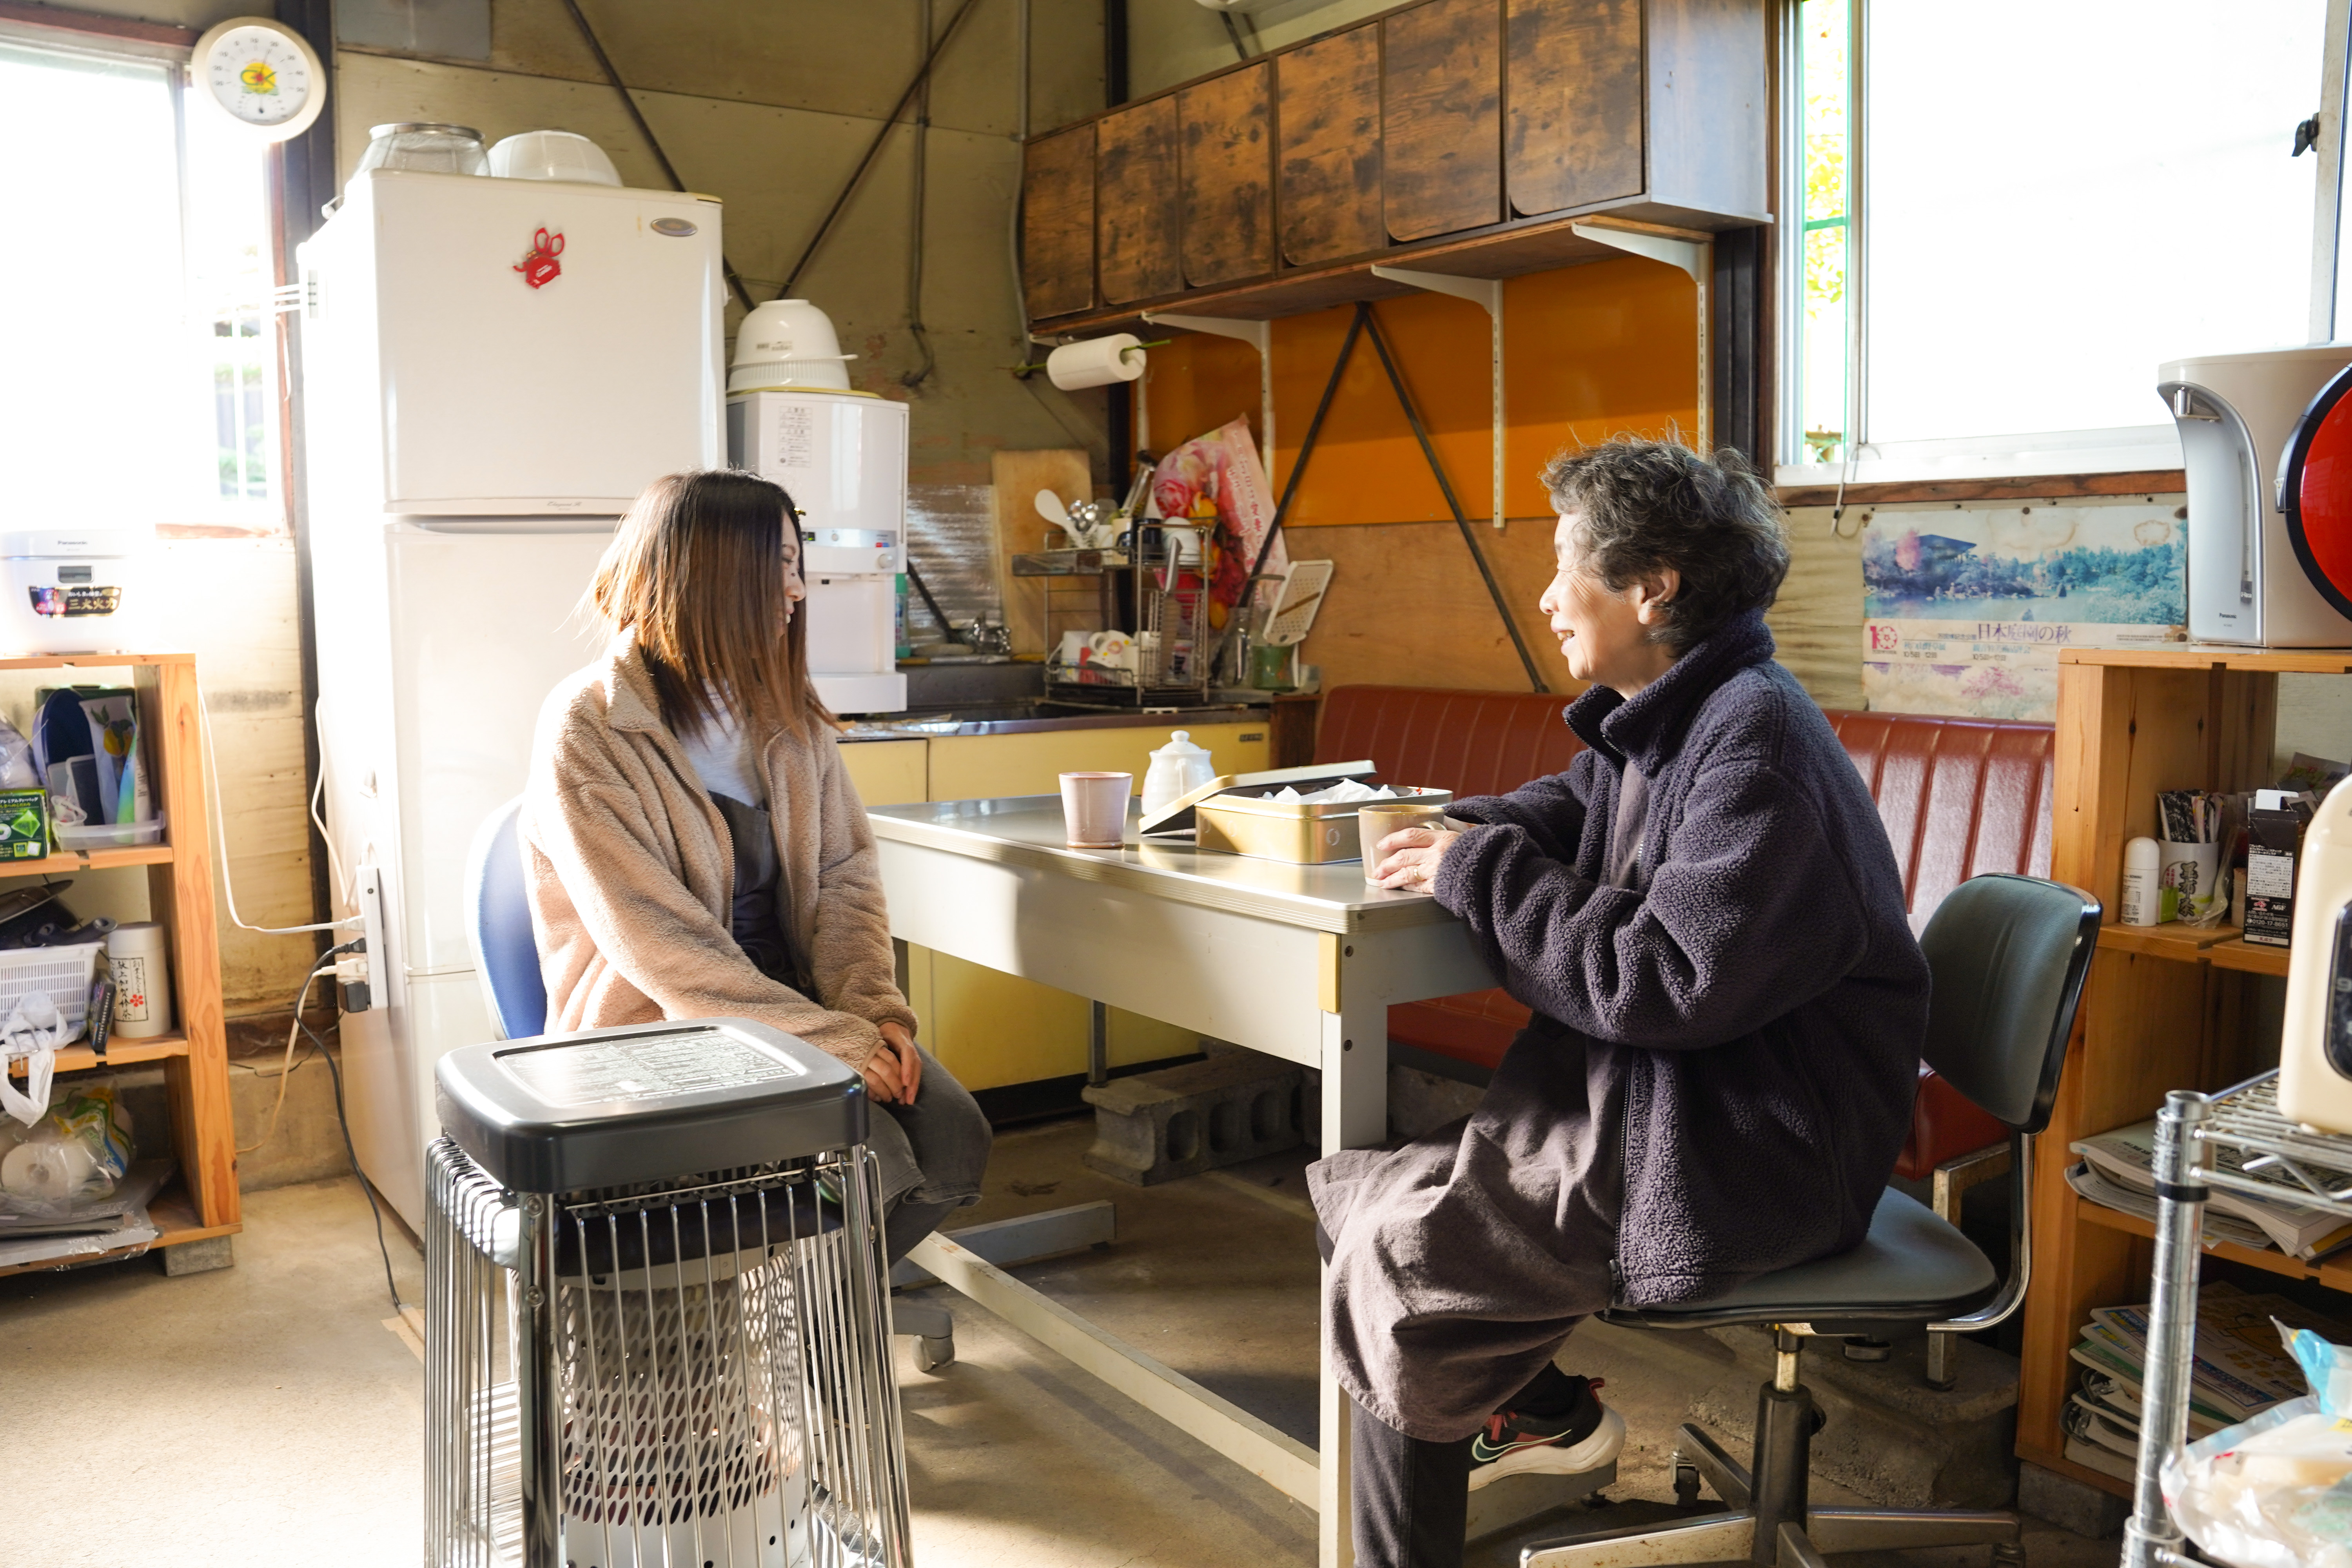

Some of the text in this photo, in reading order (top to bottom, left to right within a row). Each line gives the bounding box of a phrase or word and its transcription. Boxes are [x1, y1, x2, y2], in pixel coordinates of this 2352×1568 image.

[1978, 623, 2072, 643] 日本庭園の秋
